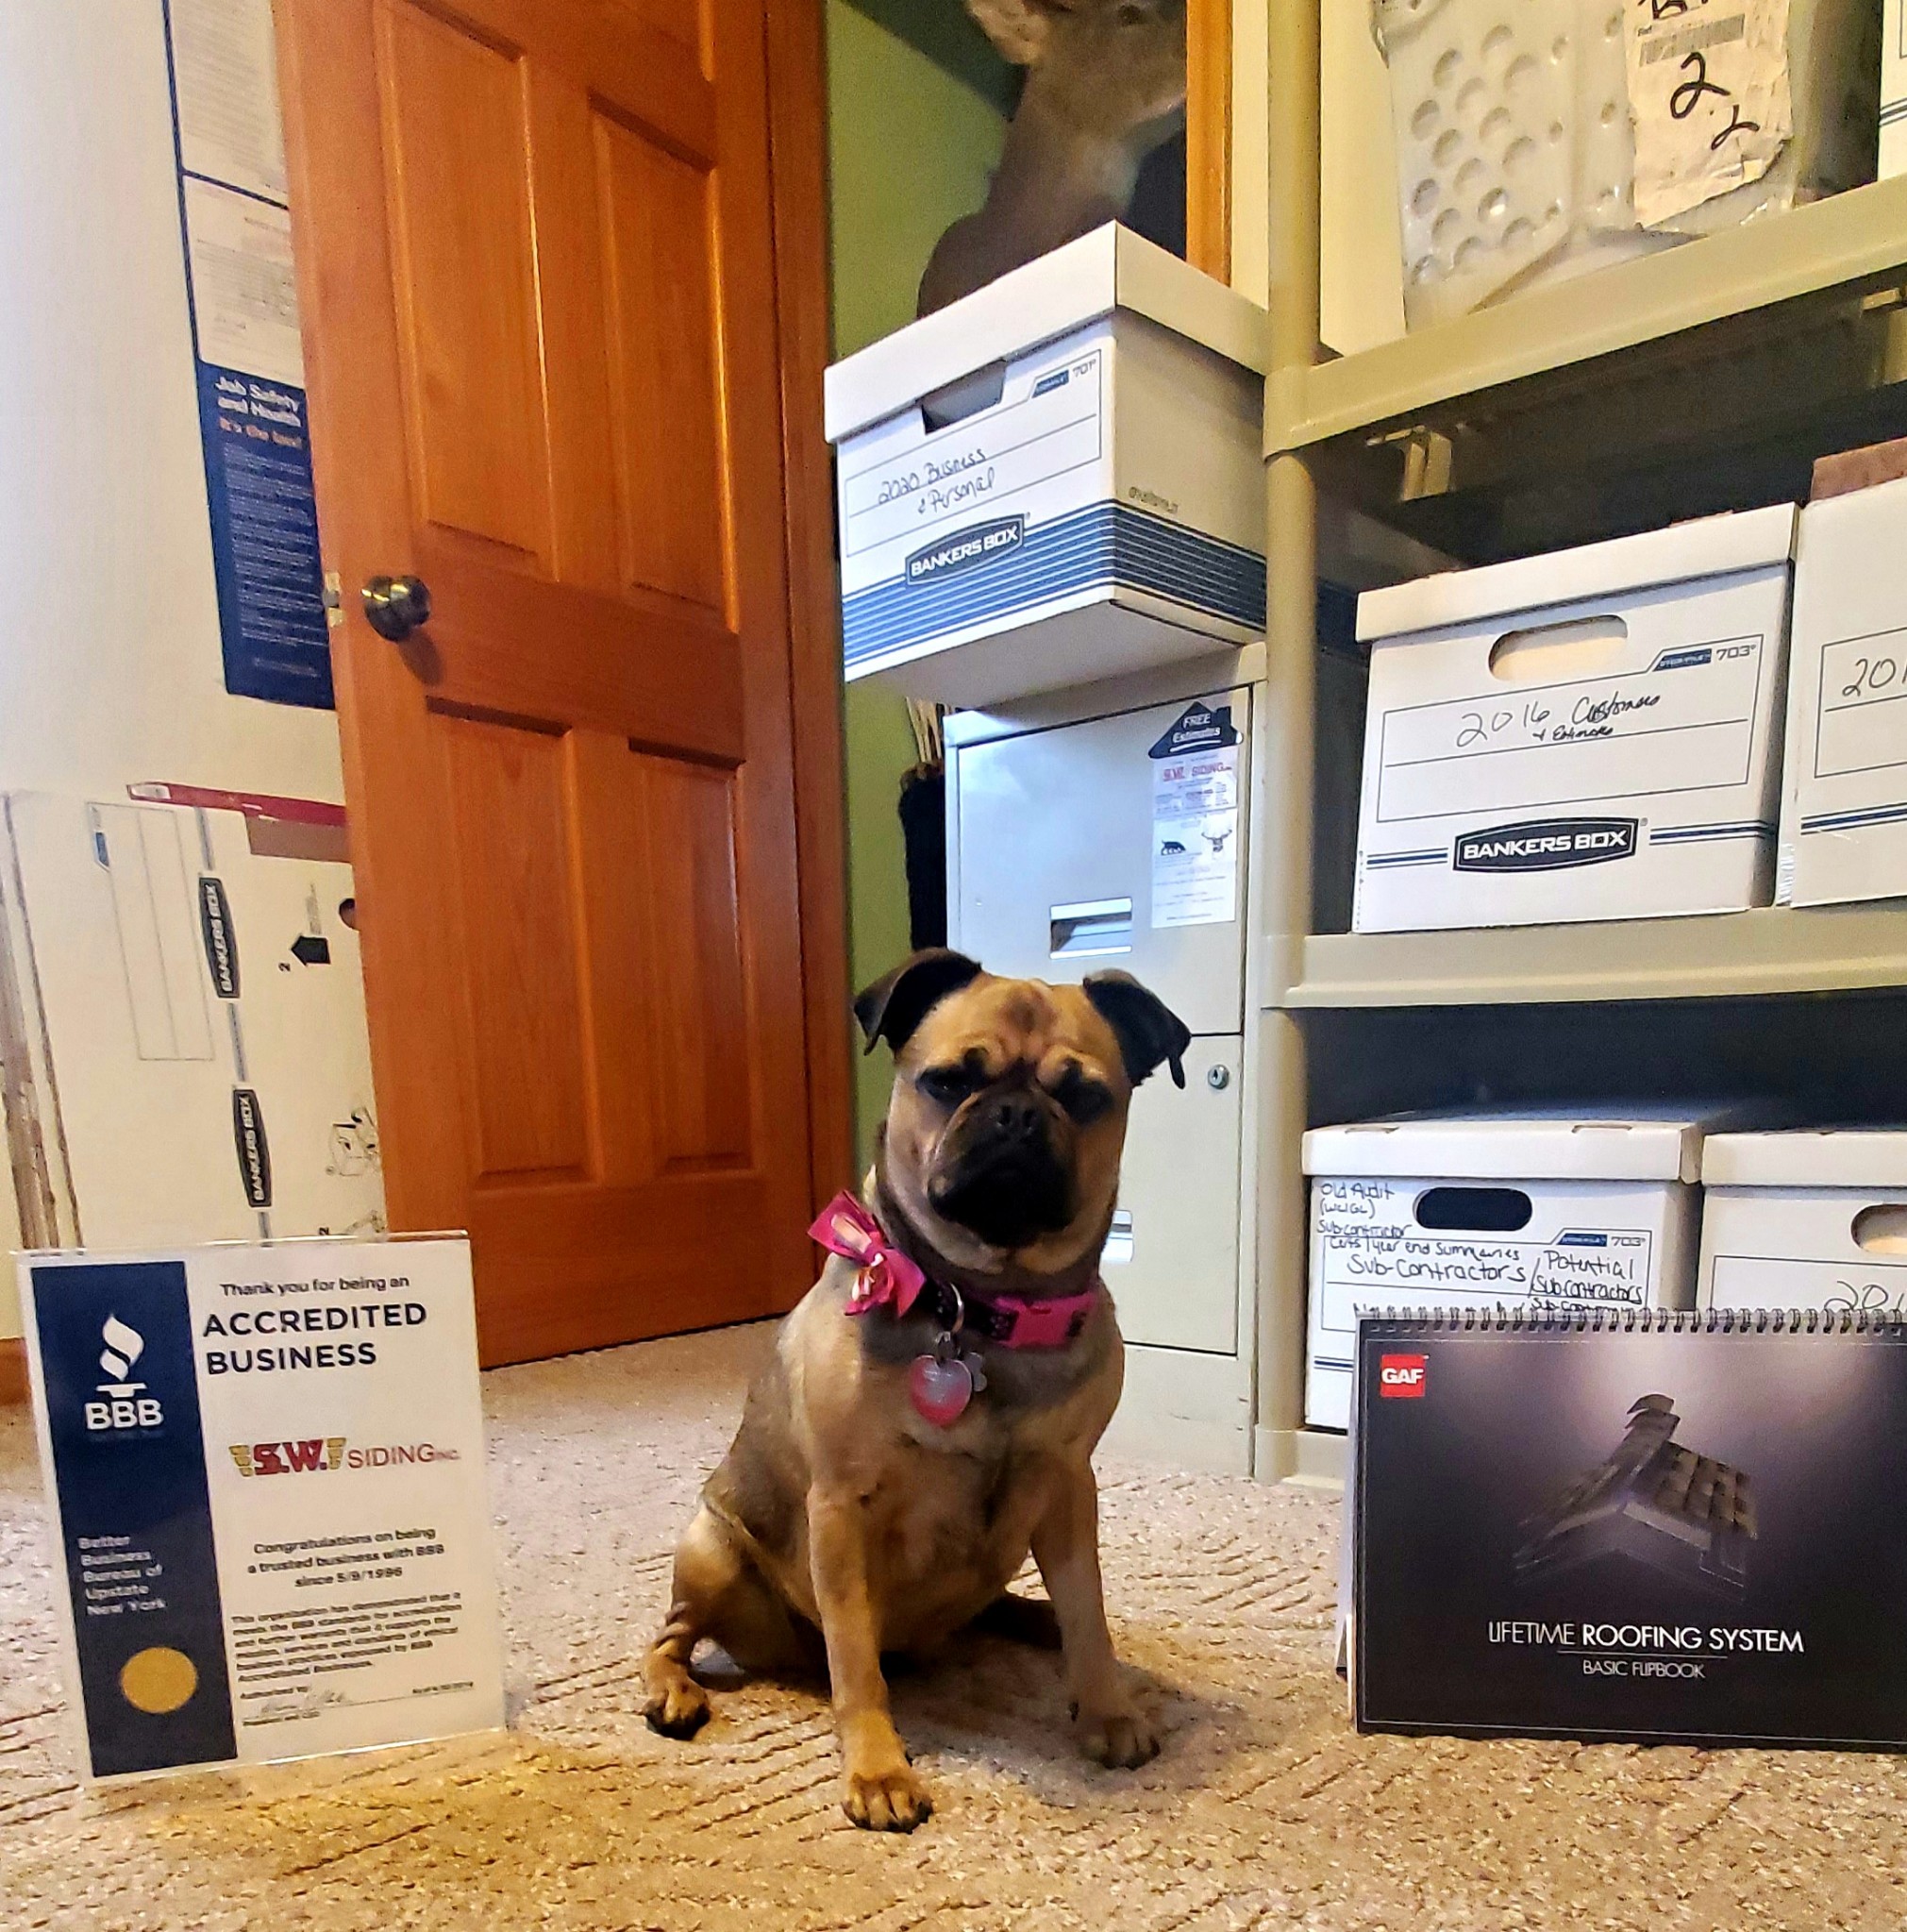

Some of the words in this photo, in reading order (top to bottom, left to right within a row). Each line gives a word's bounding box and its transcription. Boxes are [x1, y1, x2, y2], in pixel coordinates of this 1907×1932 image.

[1670, 52, 1731, 119] 2
[878, 472, 920, 505] 2020
[911, 540, 982, 577] BANKERS
[983, 526, 1018, 550] BOX
[1182, 713, 1211, 729] FREE
[1457, 701, 1550, 748] 2016
[1464, 835, 1571, 860] BANKERS
[1574, 829, 1628, 849] BOX
[206, 884, 221, 917] BOX
[210, 919, 232, 991] BANKERS
[239, 1096, 254, 1128] BOX
[245, 1130, 264, 1200] BANKERS
[1321, 1182, 1347, 1199] Old
[1350, 1182, 1395, 1200] Audit
[1405, 1242, 1430, 1254] end
[1544, 1250, 1633, 1280] Potential
[220, 1282, 274, 1297] Thank
[277, 1283, 309, 1297] you
[312, 1279, 335, 1292] for
[340, 1277, 386, 1291] being
[390, 1277, 410, 1287] an
[203, 1302, 427, 1336] ACCREDITED
[206, 1343, 376, 1375] BUSINESS
[1381, 1368, 1424, 1385] GAF
[85, 1399, 164, 1429] BBB
[347, 1443, 435, 1469] SIDING
[254, 1534, 372, 1554] Congratulations
[375, 1532, 393, 1542] on
[395, 1527, 436, 1540] being
[247, 1565, 257, 1574] a
[259, 1556, 313, 1572] trusted
[316, 1552, 380, 1567] business
[383, 1548, 414, 1560] with
[294, 1571, 334, 1588] since
[1488, 1621, 1576, 1645] LIFETIME
[1581, 1623, 1702, 1649] ROOFING
[1709, 1627, 1805, 1653] SYSTEM
[1583, 1659, 1629, 1676] BASIC
[1631, 1661, 1706, 1679] FLIPBOOK
